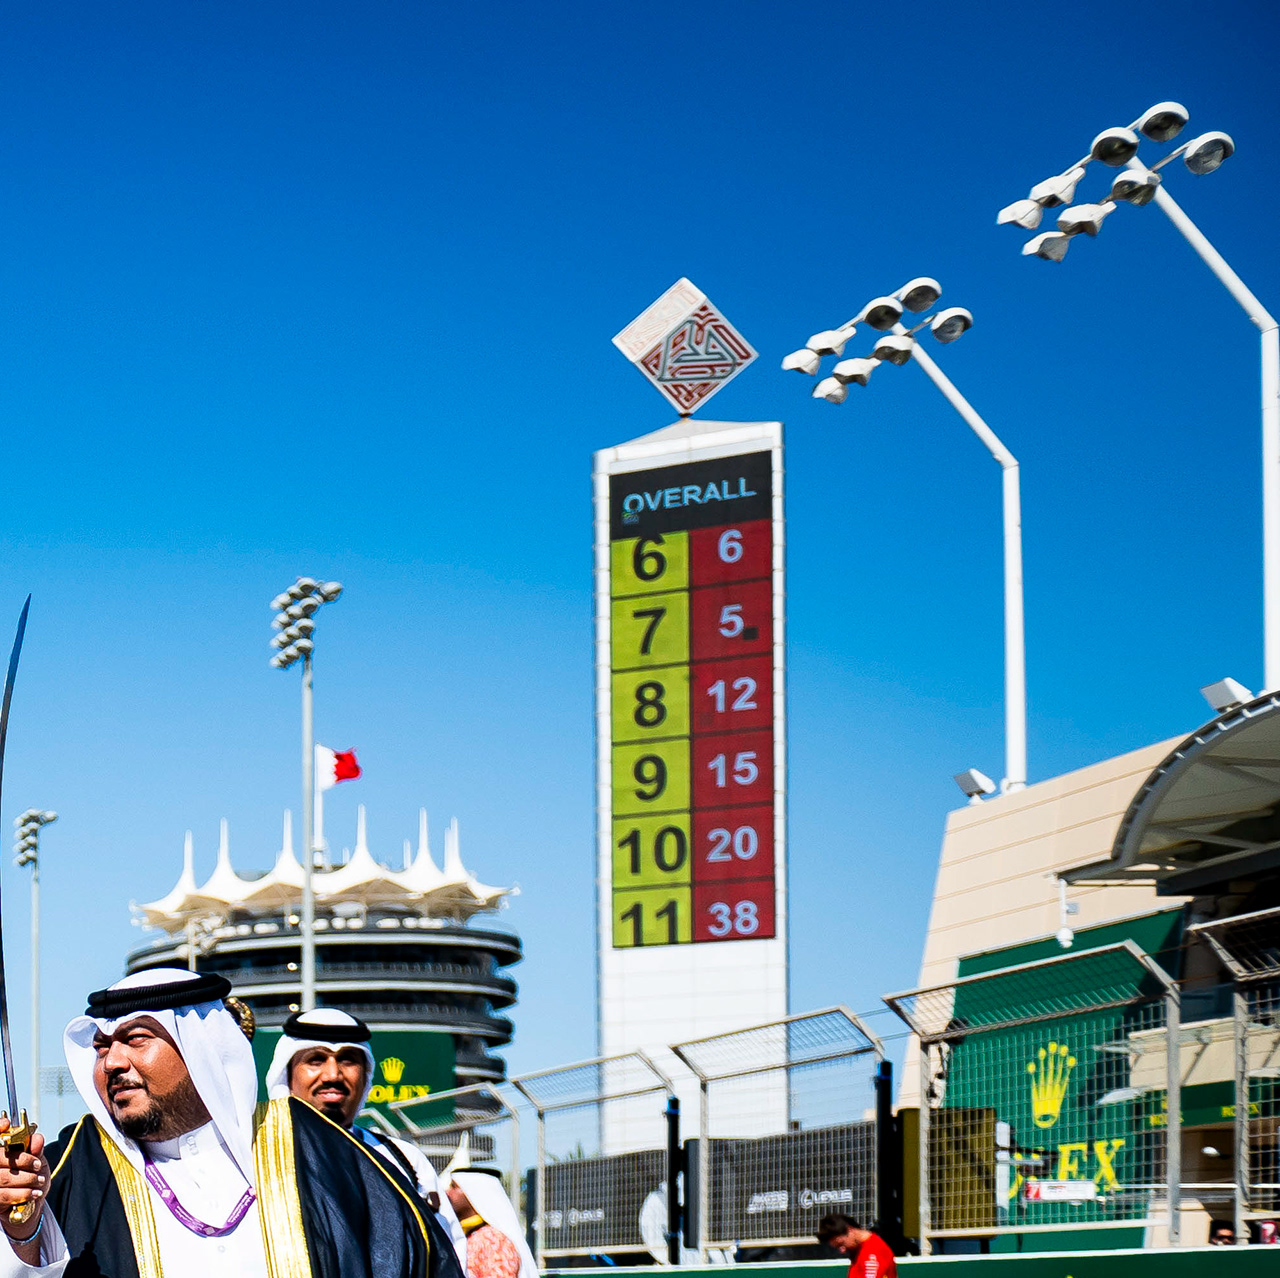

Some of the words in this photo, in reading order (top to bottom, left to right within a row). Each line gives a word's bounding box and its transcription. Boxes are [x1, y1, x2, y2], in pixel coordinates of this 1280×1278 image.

[622, 477, 758, 514] OVERALL
[633, 531, 667, 582] 6
[718, 529, 744, 563] 6
[633, 607, 667, 655] 7
[718, 604, 745, 638] 5
[634, 680, 667, 728] 8
[707, 677, 758, 713] 12
[633, 754, 668, 802] 9
[707, 752, 759, 788] 15
[618, 825, 687, 875] 10
[706, 826, 759, 864] 20
[620, 901, 679, 946] 11
[707, 901, 760, 936] 38
[366, 1085, 431, 1103] OLEX
